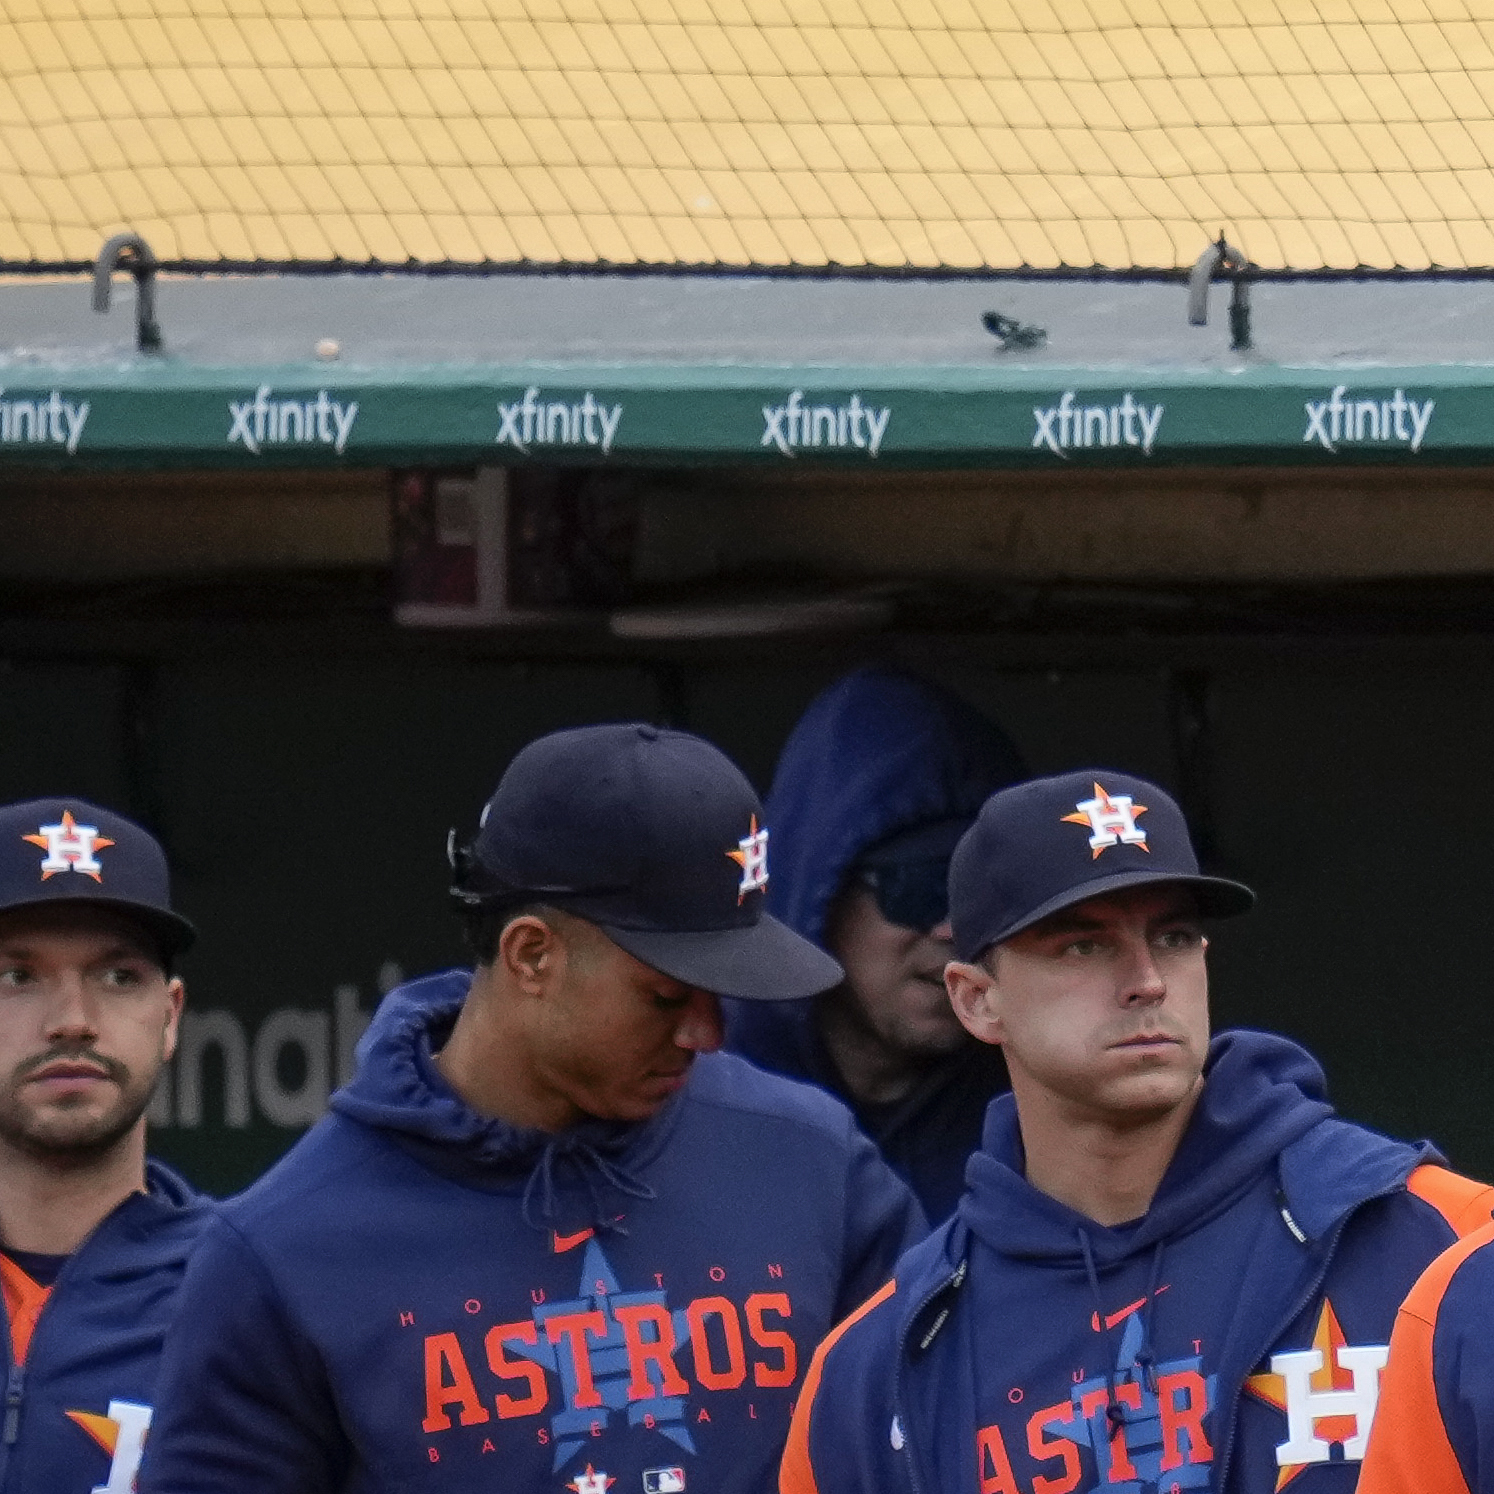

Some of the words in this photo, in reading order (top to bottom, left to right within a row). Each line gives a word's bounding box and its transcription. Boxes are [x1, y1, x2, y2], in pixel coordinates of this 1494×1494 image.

[227, 383, 359, 455] xfinity
[496, 385, 624, 455] xfinity
[761, 391, 890, 459] xfinity
[1033, 392, 1163, 459] xfinity
[1303, 385, 1435, 454] xfinity
[39, 824, 102, 873] H
[1076, 795, 1147, 849] H
[400, 1263, 784, 1328] HOUSTON
[421, 1292, 798, 1434] ASTROS
